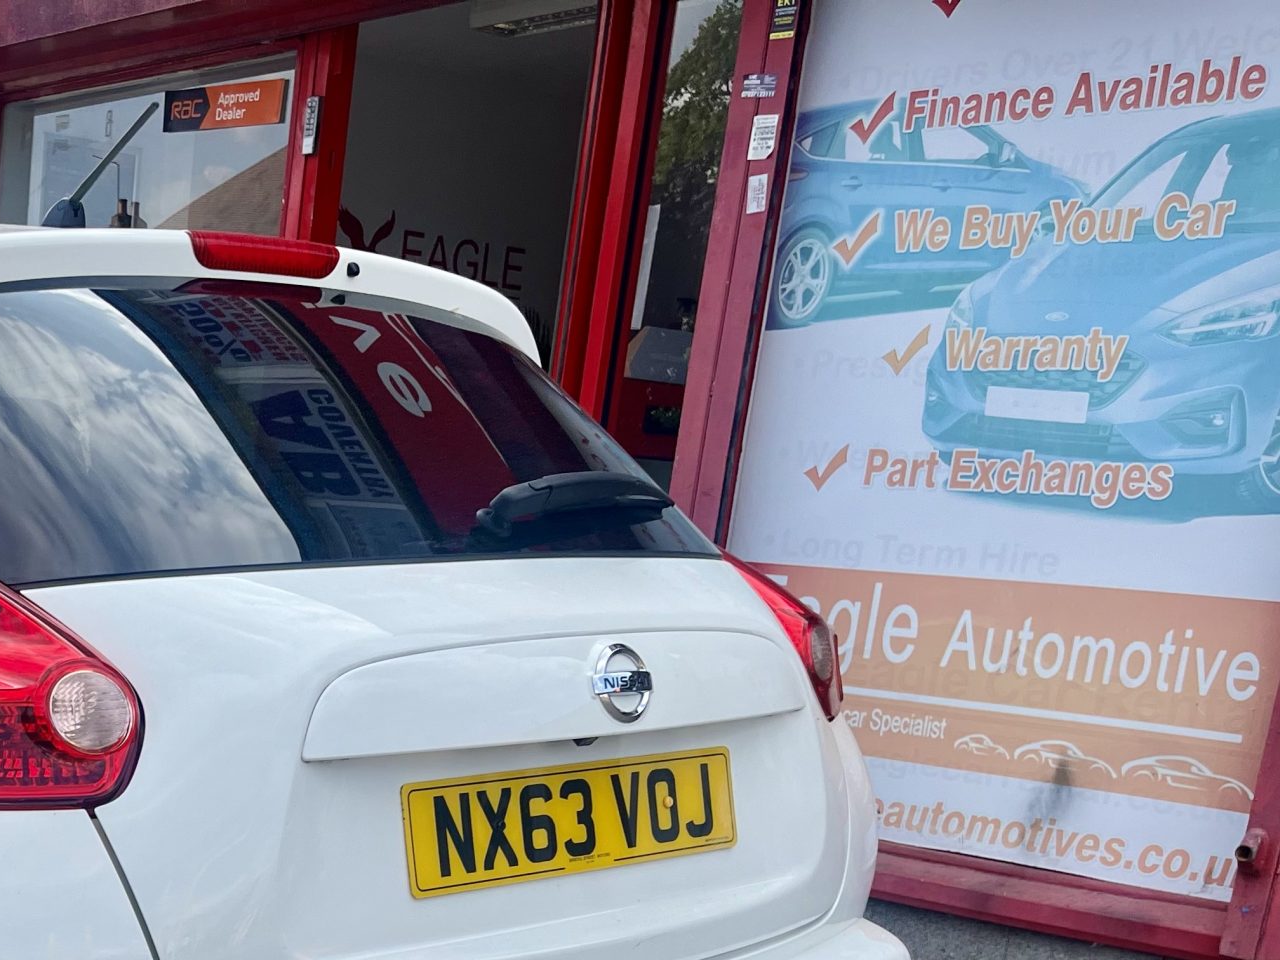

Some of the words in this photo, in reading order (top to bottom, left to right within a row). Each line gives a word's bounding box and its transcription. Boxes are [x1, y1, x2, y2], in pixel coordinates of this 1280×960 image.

[215, 108, 247, 121] Dealer
[218, 88, 260, 108] Approved
[904, 86, 1054, 131] Finance
[1064, 55, 1268, 116] Available
[895, 208, 951, 252] We
[960, 206, 1040, 257] Buy
[1051, 199, 1144, 244] Your
[1154, 192, 1235, 240] Car
[401, 229, 526, 291] EAGLE
[946, 328, 1127, 382] Warranty
[863, 448, 940, 489] Part
[947, 448, 1175, 508] Exchanges
[940, 609, 1261, 701] Automotive
[869, 708, 947, 739] Specialist
[433, 779, 596, 878] NX63
[610, 762, 714, 849] VOJ
